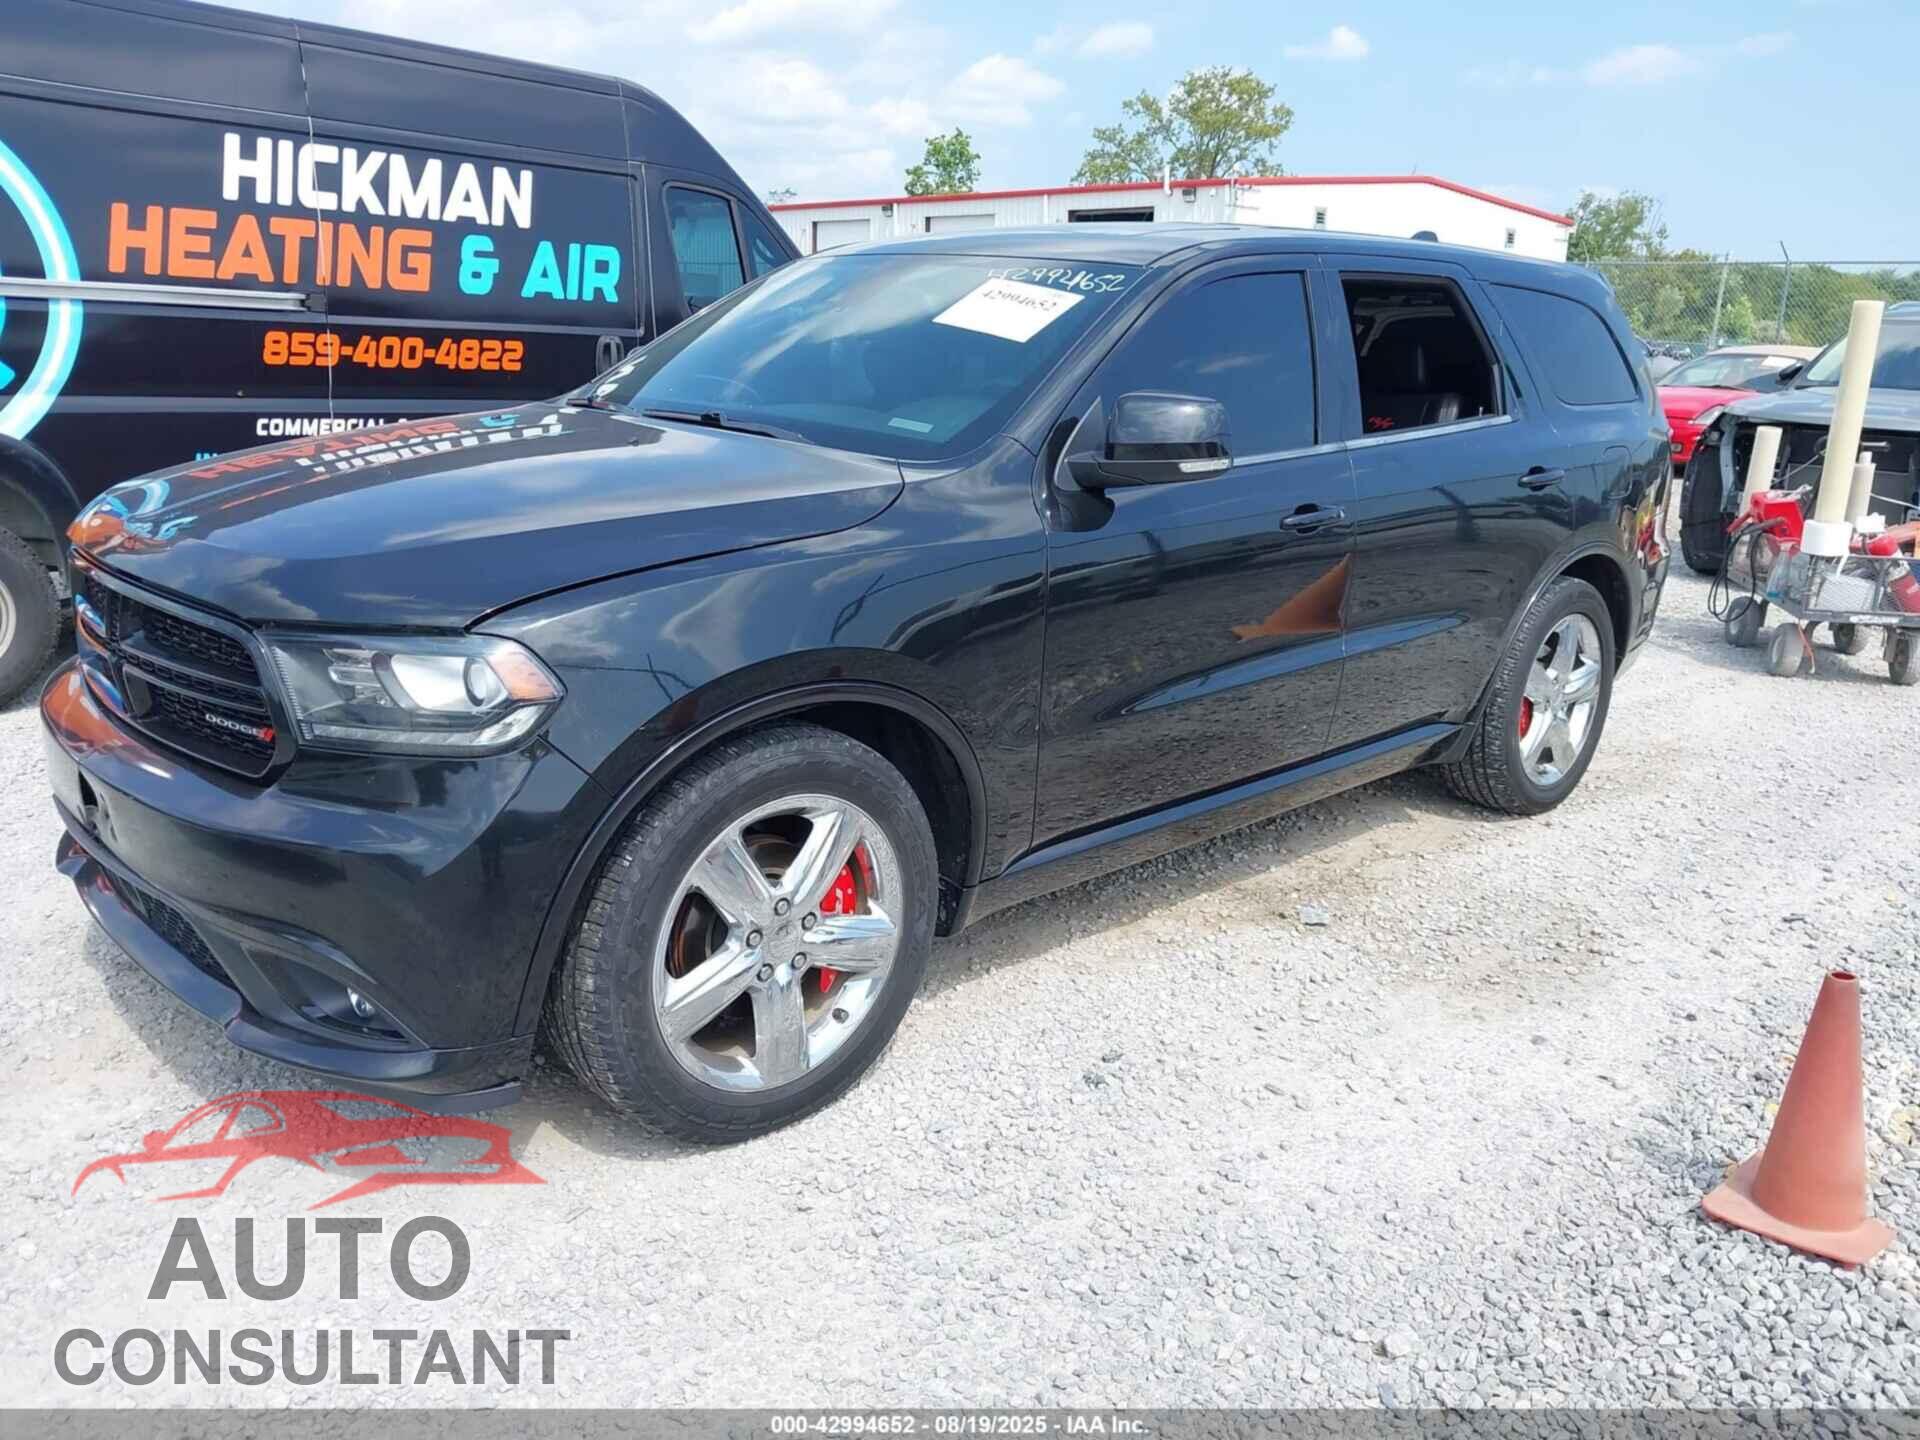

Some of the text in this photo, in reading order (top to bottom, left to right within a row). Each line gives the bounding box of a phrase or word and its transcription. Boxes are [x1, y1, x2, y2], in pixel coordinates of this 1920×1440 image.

[222, 132, 533, 229] HICKMAN
[107, 202, 621, 303] HEATING & AIR
[262, 330, 525, 371] 859-400-4822
[205, 713, 262, 736] DODGE
